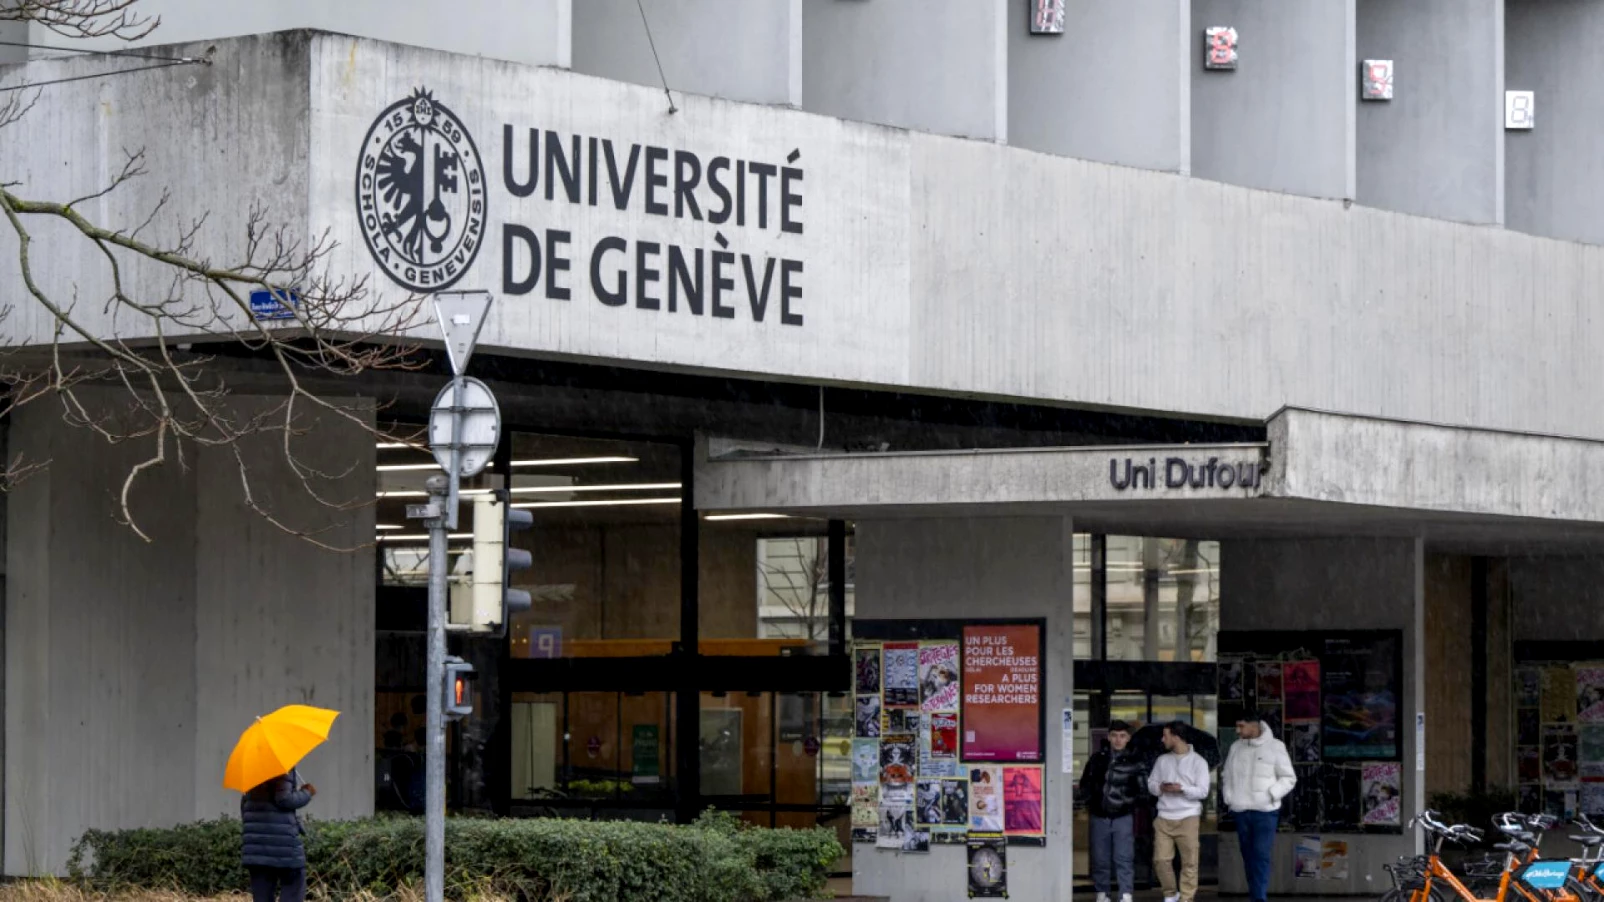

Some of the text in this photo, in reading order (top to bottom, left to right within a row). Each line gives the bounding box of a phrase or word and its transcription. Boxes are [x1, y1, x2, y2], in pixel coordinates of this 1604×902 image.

[384, 112, 462, 144] 15 59
[503, 123, 804, 234] UNIVERSITÉ
[362, 153, 483, 285] SCHOLA GENEVENSIS
[503, 222, 804, 326] DE GENÈVE
[1109, 457, 1266, 490] Uni Dufour
[965, 635, 1007, 645] UN PLUS
[965, 646, 993, 656] POUR
[996, 646, 1014, 656] LES
[965, 656, 1038, 666] CHERCHEUSES
[1001, 674, 1038, 683] A PLUS
[974, 684, 1038, 693] FOR WOMEN
[965, 694, 1038, 704] RESEARCHERS
